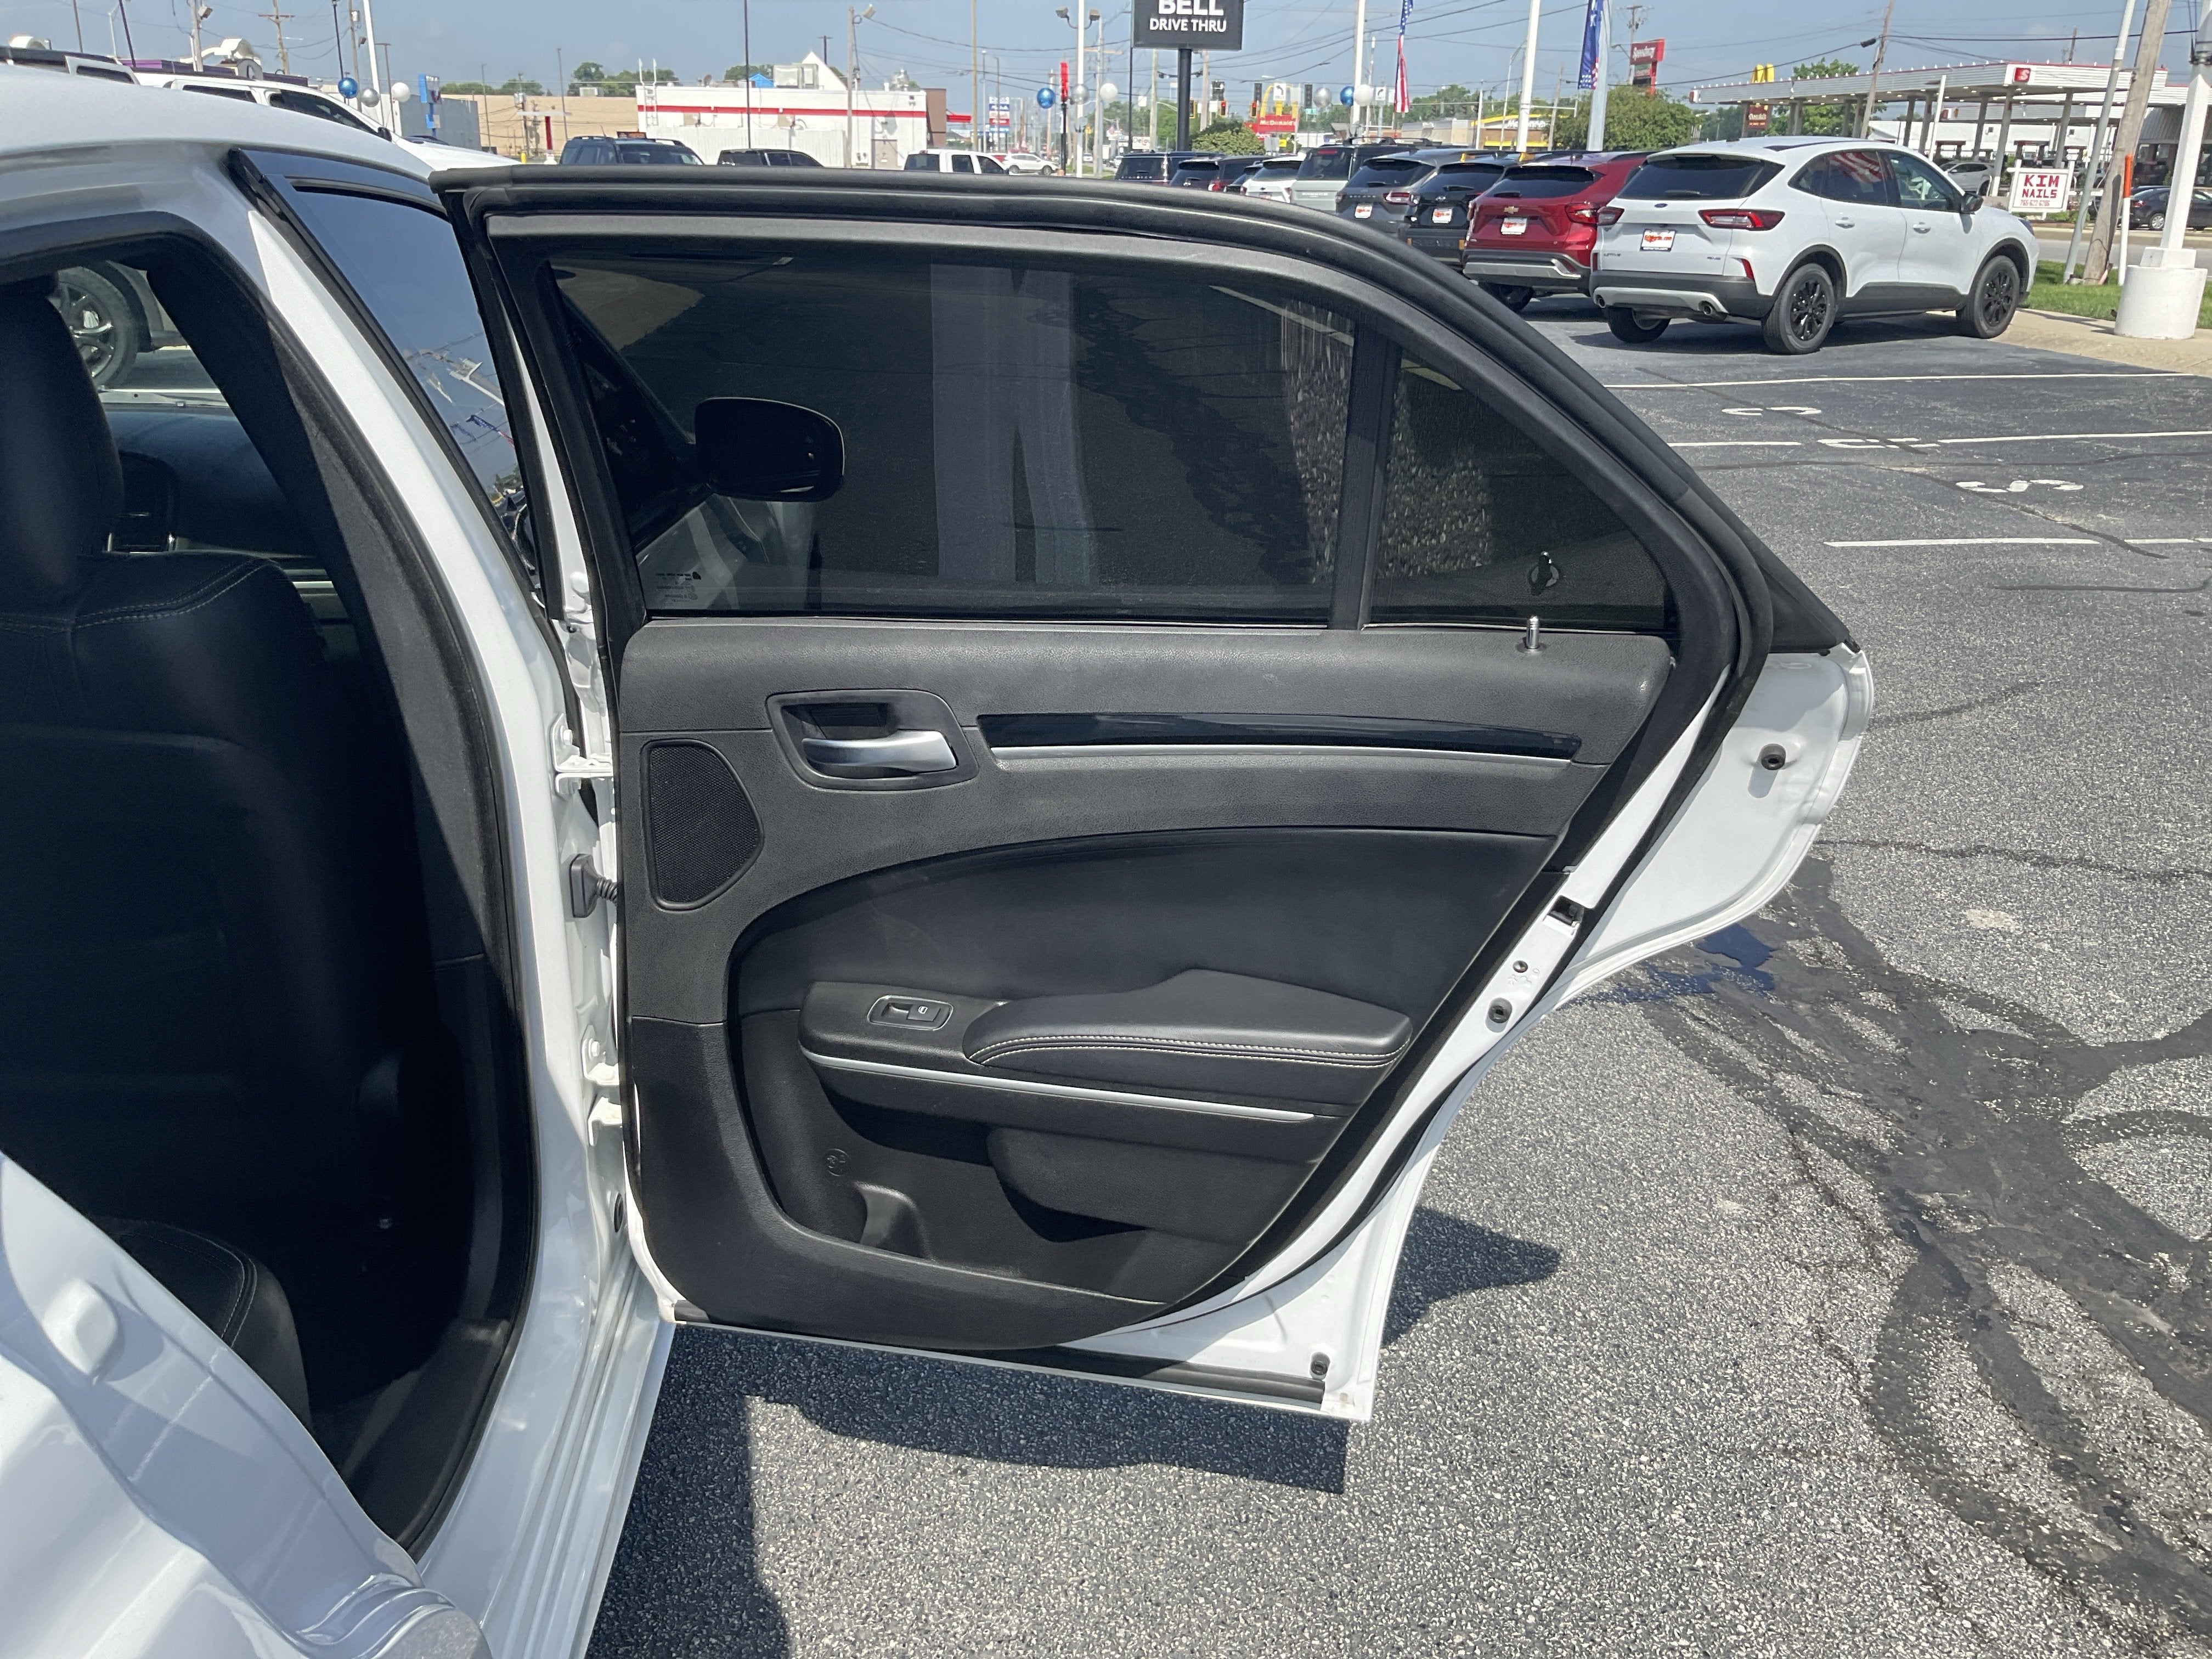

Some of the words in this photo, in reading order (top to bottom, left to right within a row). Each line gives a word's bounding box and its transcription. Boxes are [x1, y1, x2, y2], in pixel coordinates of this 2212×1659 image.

[1158, 0, 1224, 16] BELL
[1149, 18, 1188, 31] DRIVE
[1190, 19, 1227, 33] THRU
[2019, 69, 2030, 81] S
[2024, 174, 2060, 188] KIM
[2022, 188, 2058, 199] NAILS
